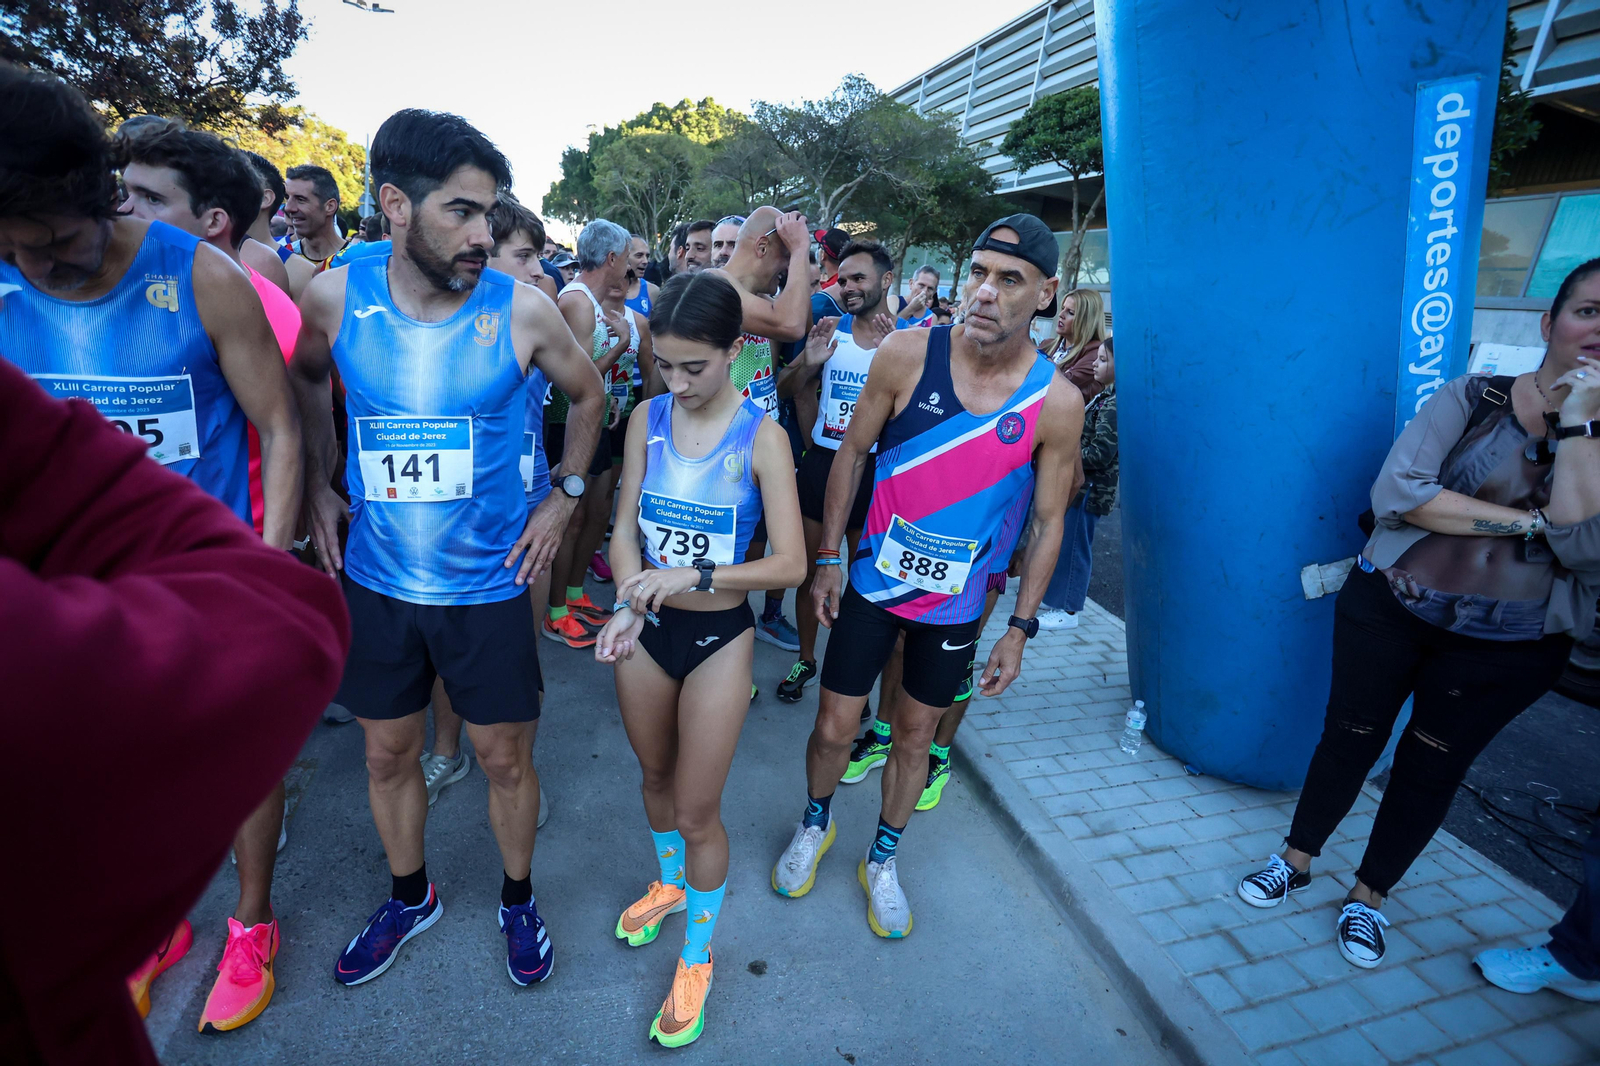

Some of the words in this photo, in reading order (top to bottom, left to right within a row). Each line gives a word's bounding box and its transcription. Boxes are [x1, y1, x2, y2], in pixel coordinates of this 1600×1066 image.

[1404, 93, 1470, 427] deportes@ayt
[53, 382, 80, 391] XLIII
[82, 383, 126, 393] Carrera
[129, 382, 175, 394] Popular
[112, 396, 128, 405] de
[131, 396, 163, 405] Jerez
[917, 401, 944, 416] VIATOR
[369, 422, 385, 430] XLIII
[386, 421, 420, 430] Carrera
[422, 421, 458, 430] Popular
[376, 432, 406, 441] Ciudad
[408, 432, 421, 441] de
[422, 432, 447, 441] Jerez
[381, 453, 440, 483] 141
[650, 497, 665, 506] XLIII
[667, 501, 693, 512] Carrera
[695, 505, 725, 517] Popular
[656, 508, 681, 520] Ciudad
[682, 513, 693, 522] de
[694, 516, 714, 525] Jerez
[656, 526, 710, 558] 739
[902, 524, 915, 536] XLIII
[916, 532, 940, 544] Carrera
[941, 539, 966, 548] Popular
[905, 535, 928, 549] Ciudad
[928, 544, 938, 552] de
[938, 546, 956, 555] Jerez
[899, 550, 949, 581] 888
